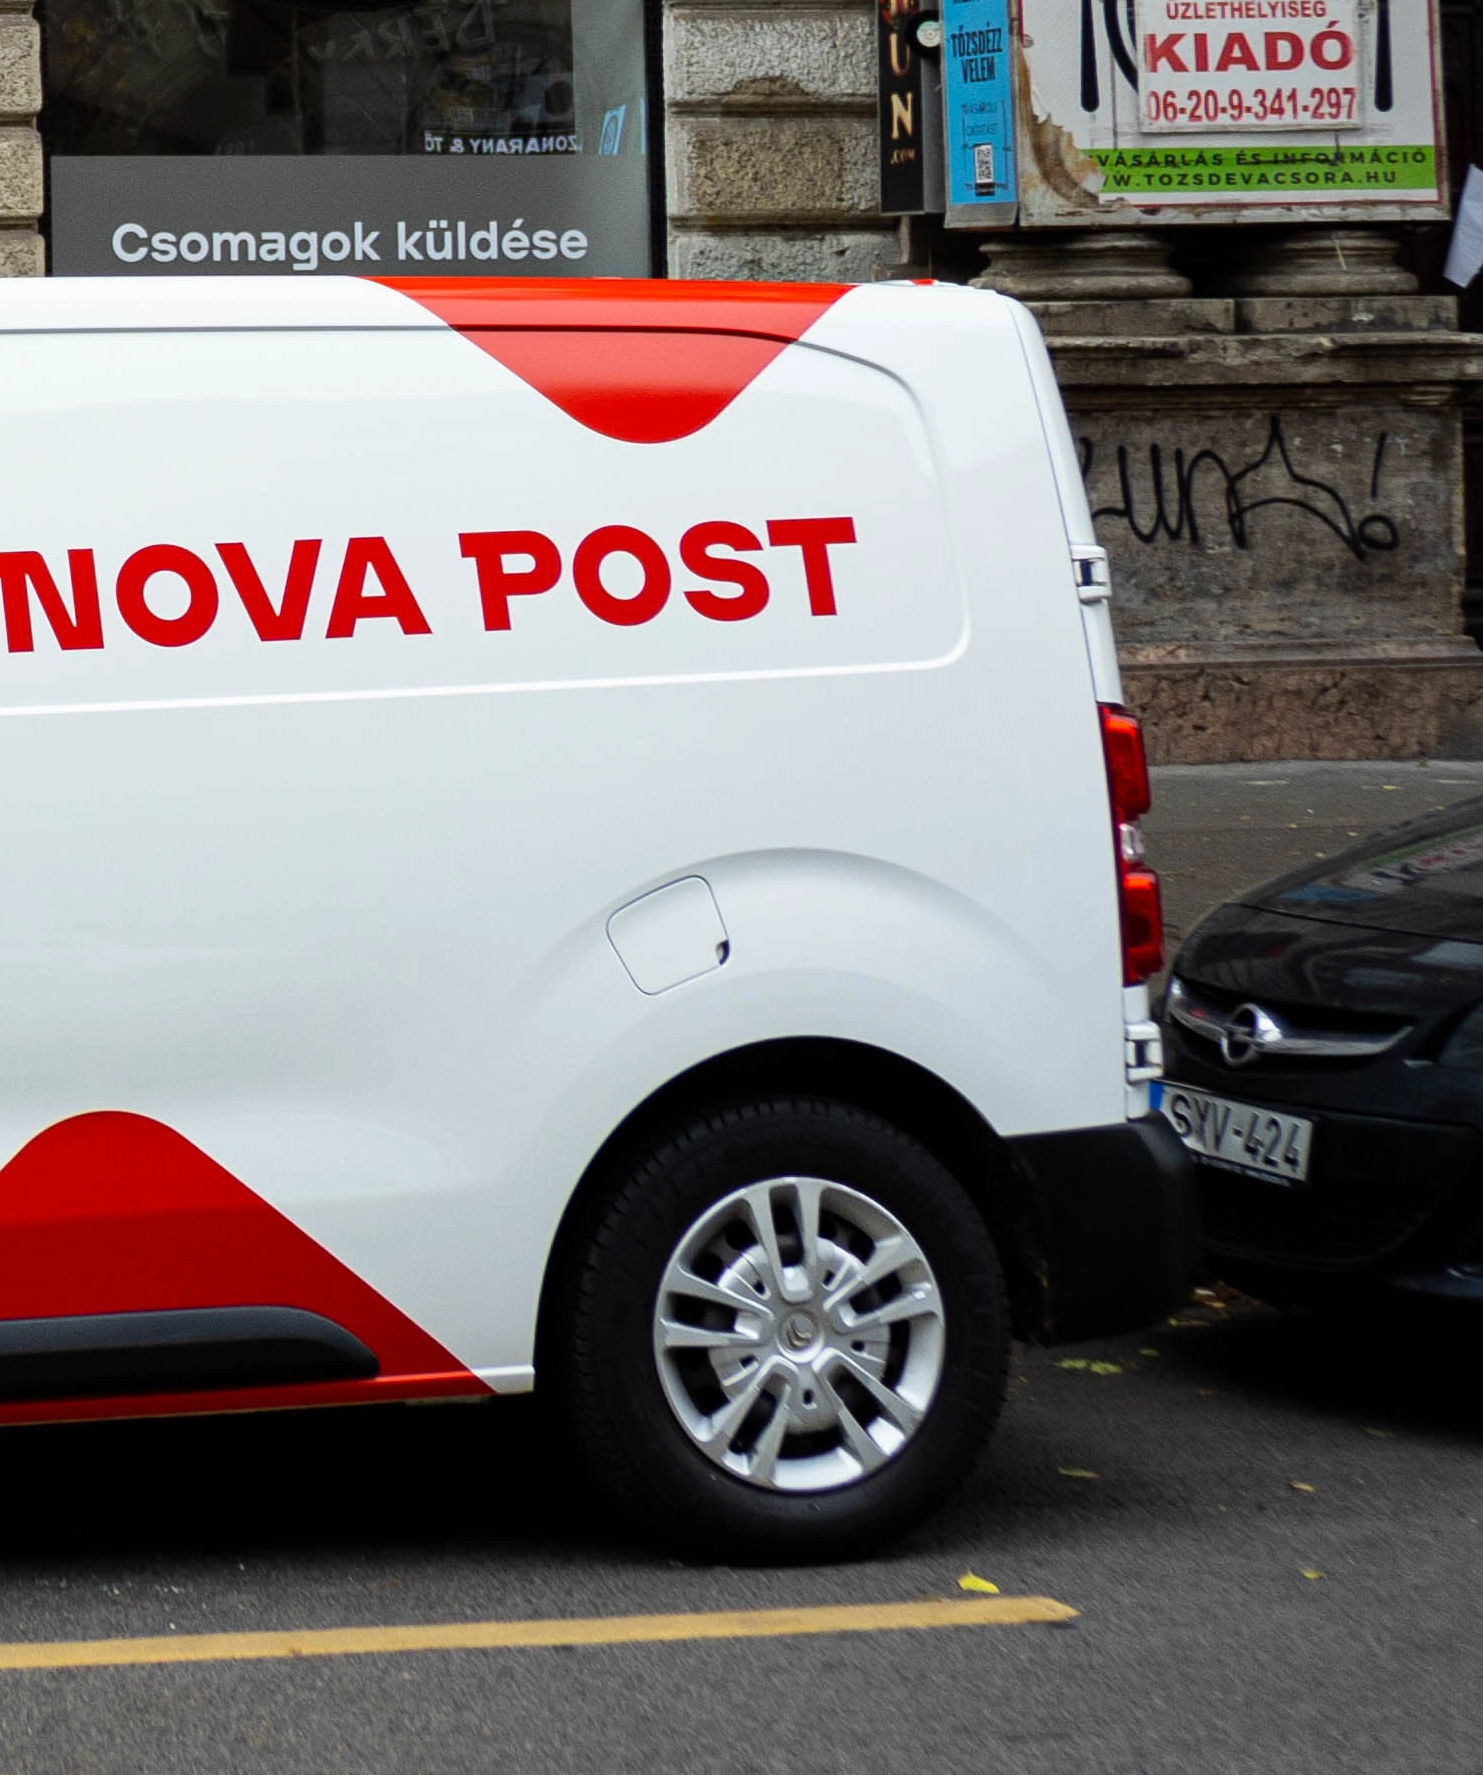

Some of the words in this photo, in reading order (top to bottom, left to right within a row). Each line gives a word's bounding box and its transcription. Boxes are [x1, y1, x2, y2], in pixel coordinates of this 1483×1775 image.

[1143, 20, 1356, 73] KIADÓ
[961, 53, 996, 84] VELEM
[1147, 87, 1357, 123] 06-20-9-341-297
[1090, 149, 1224, 168] VÁSÁRLÁS
[1101, 169, 1397, 188] W.TOZSDEVACSORA.HU
[112, 221, 381, 271] Csomagok
[396, 220, 589, 262] küldése
[460, 516, 857, 633] POST
